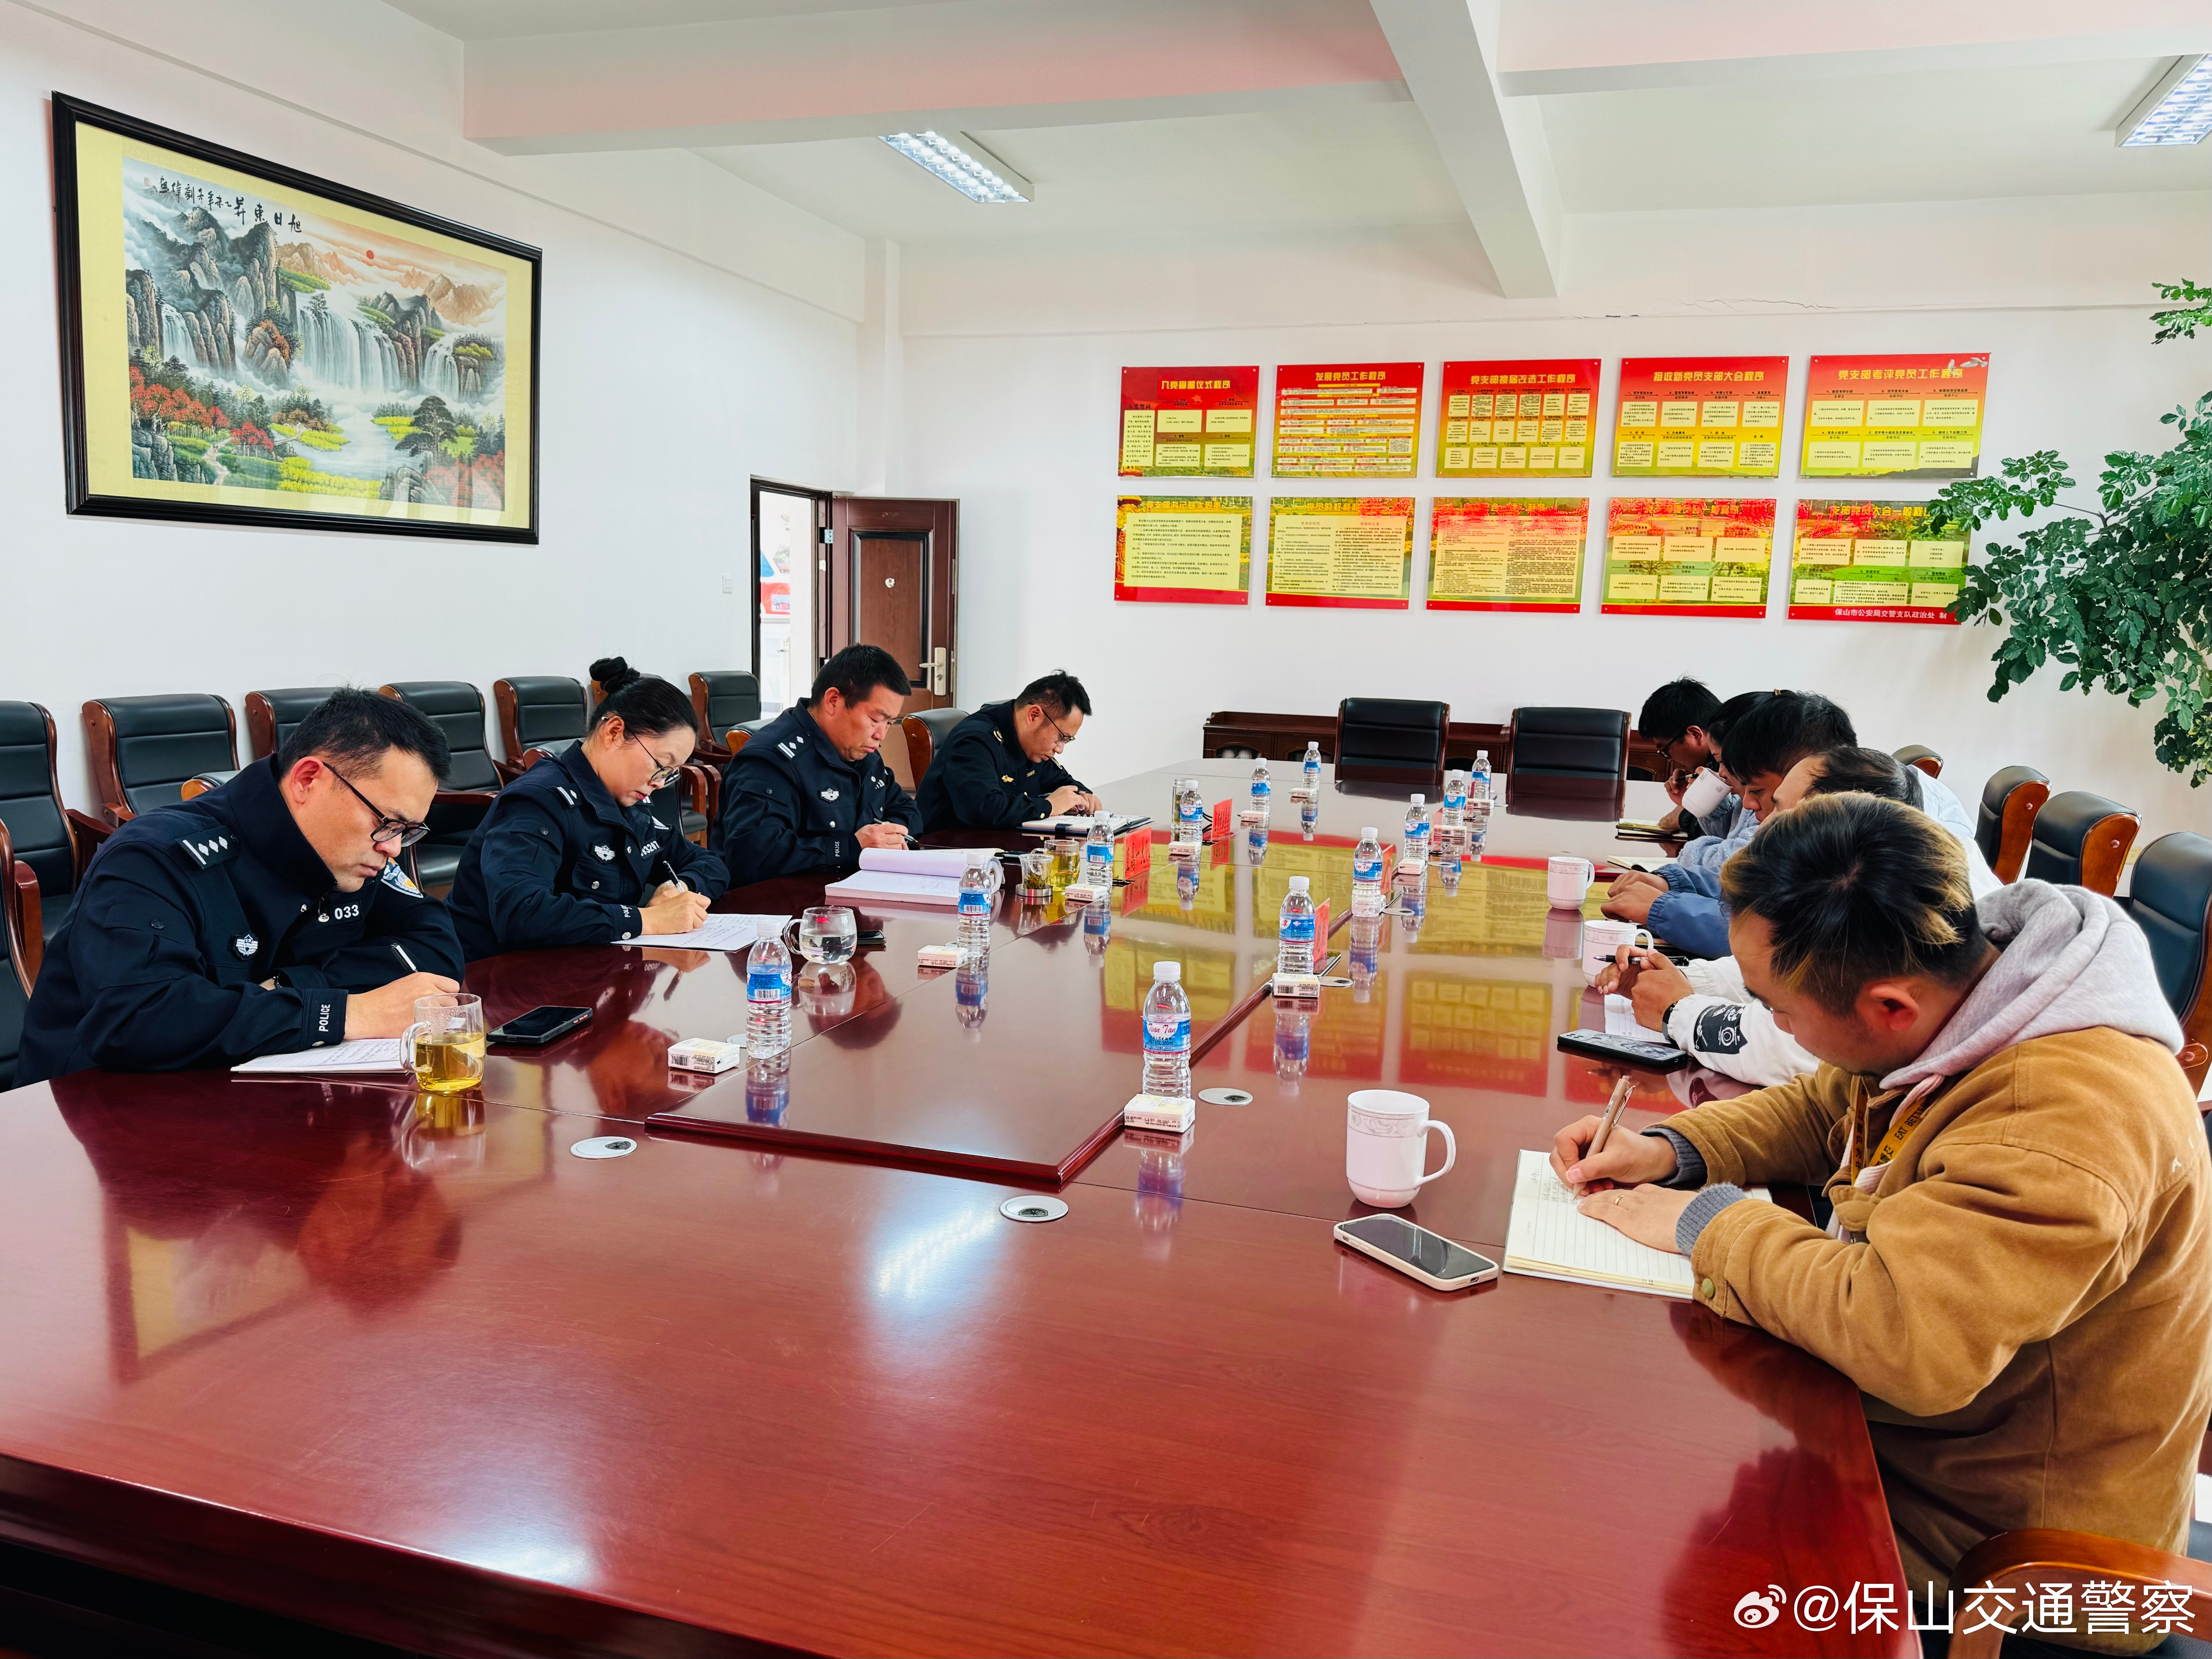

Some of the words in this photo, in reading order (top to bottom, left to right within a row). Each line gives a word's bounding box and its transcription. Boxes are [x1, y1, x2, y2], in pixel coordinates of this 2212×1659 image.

[1315, 371, 1386, 381] 发展党员工作程序
[1470, 374, 1576, 385] 党支部换届改选工作程序
[1653, 371, 1764, 382] 接收新党员支部大会程序
[1838, 368, 1964, 380] 党支部考评党员工作程序
[1307, 502, 1360, 512] 党员的权利和
[1835, 608, 1935, 619] 保山市公安局交警支队政治处
[334, 904, 359, 920] 033
[319, 1004, 331, 1032] POLICE
[1148, 1023, 1160, 1033] Tian
[1162, 1024, 1176, 1034] Tan
[1894, 1126, 1908, 1140] EAT
